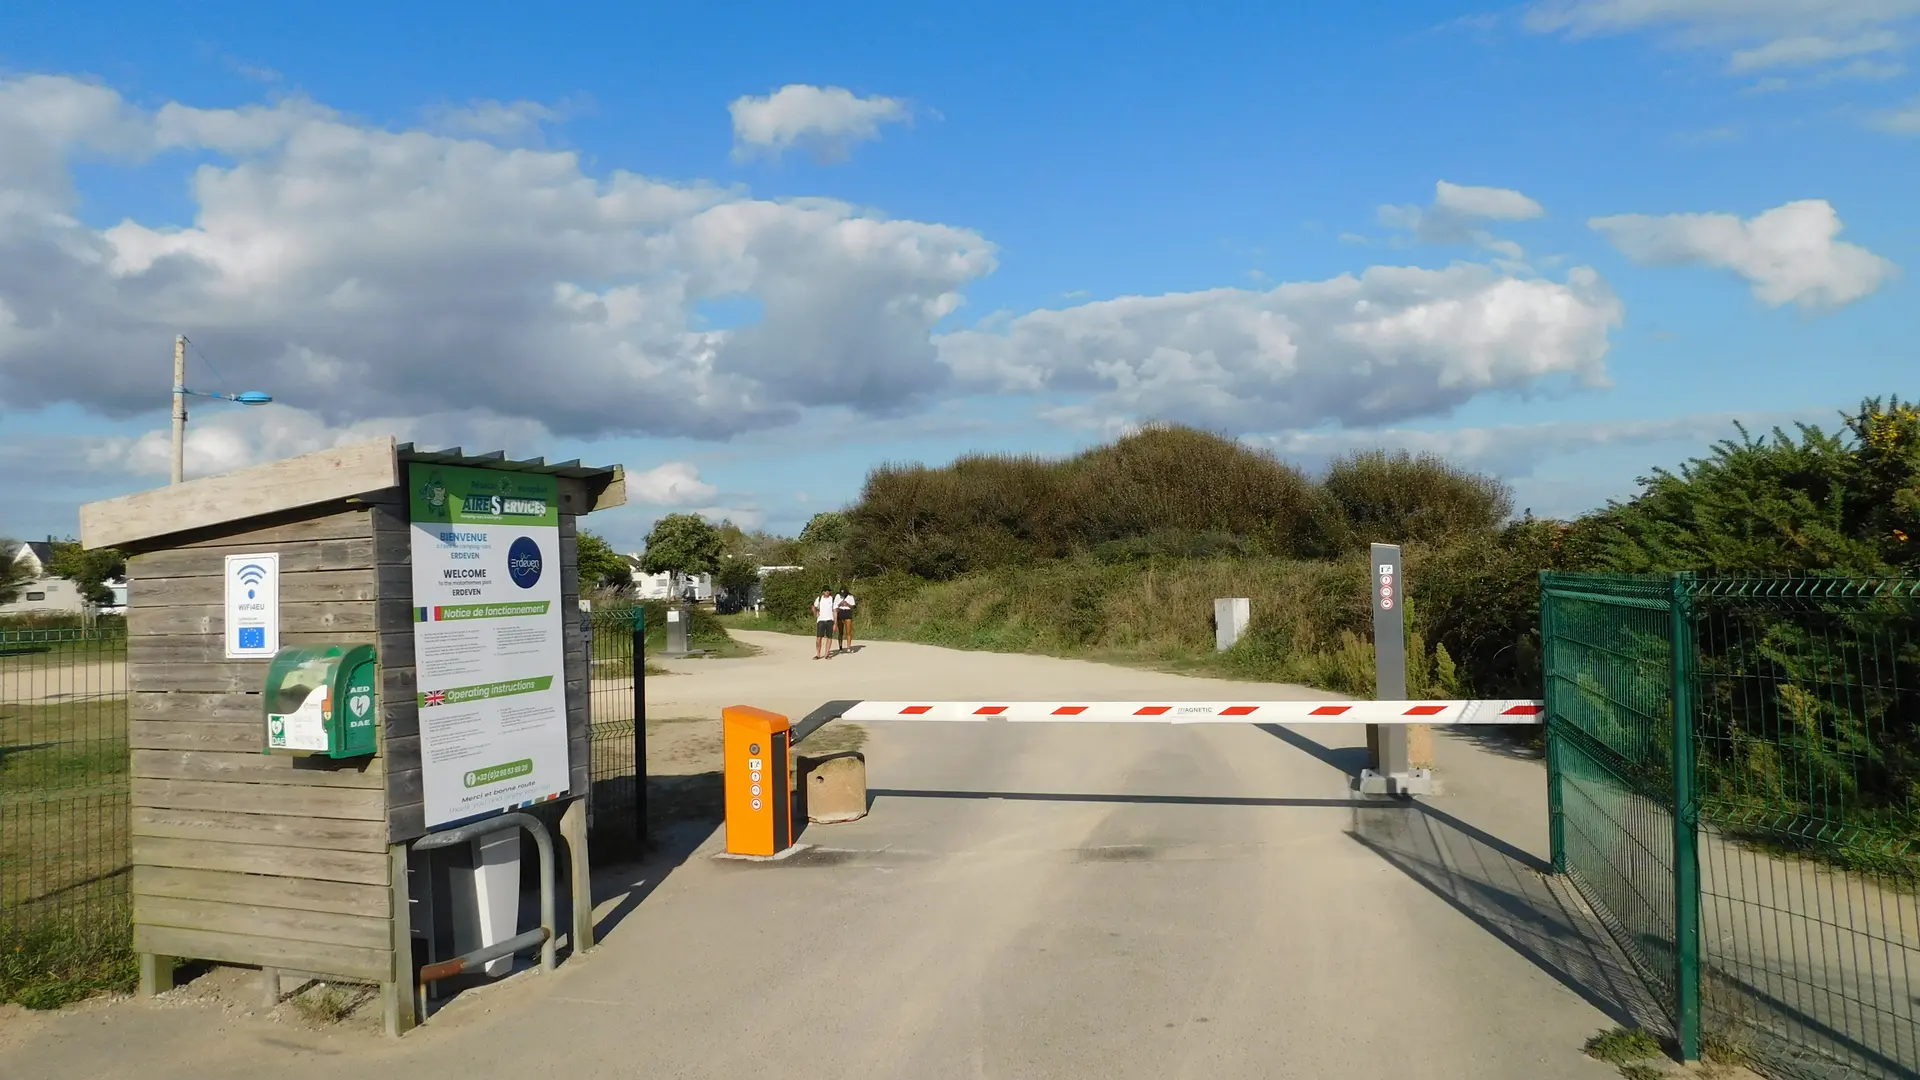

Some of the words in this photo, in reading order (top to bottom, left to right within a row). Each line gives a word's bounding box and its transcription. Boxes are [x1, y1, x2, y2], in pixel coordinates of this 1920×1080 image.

[440, 532, 488, 542] BIENVENUE
[451, 552, 480, 560] ERDEVEN
[443, 569, 487, 578] WELCOME
[452, 588, 481, 596] ERDEVEN
[443, 607, 472, 619] Notice
[473, 607, 483, 617] de
[484, 604, 545, 617] fonctionnement
[350, 685, 371, 693] AED
[447, 686, 490, 701] Operating
[490, 680, 536, 694] instructions
[350, 719, 371, 728] DAE
[461, 792, 483, 803] Merci
[484, 790, 492, 798] et
[493, 785, 516, 795] bonne
[517, 780, 536, 789] route
